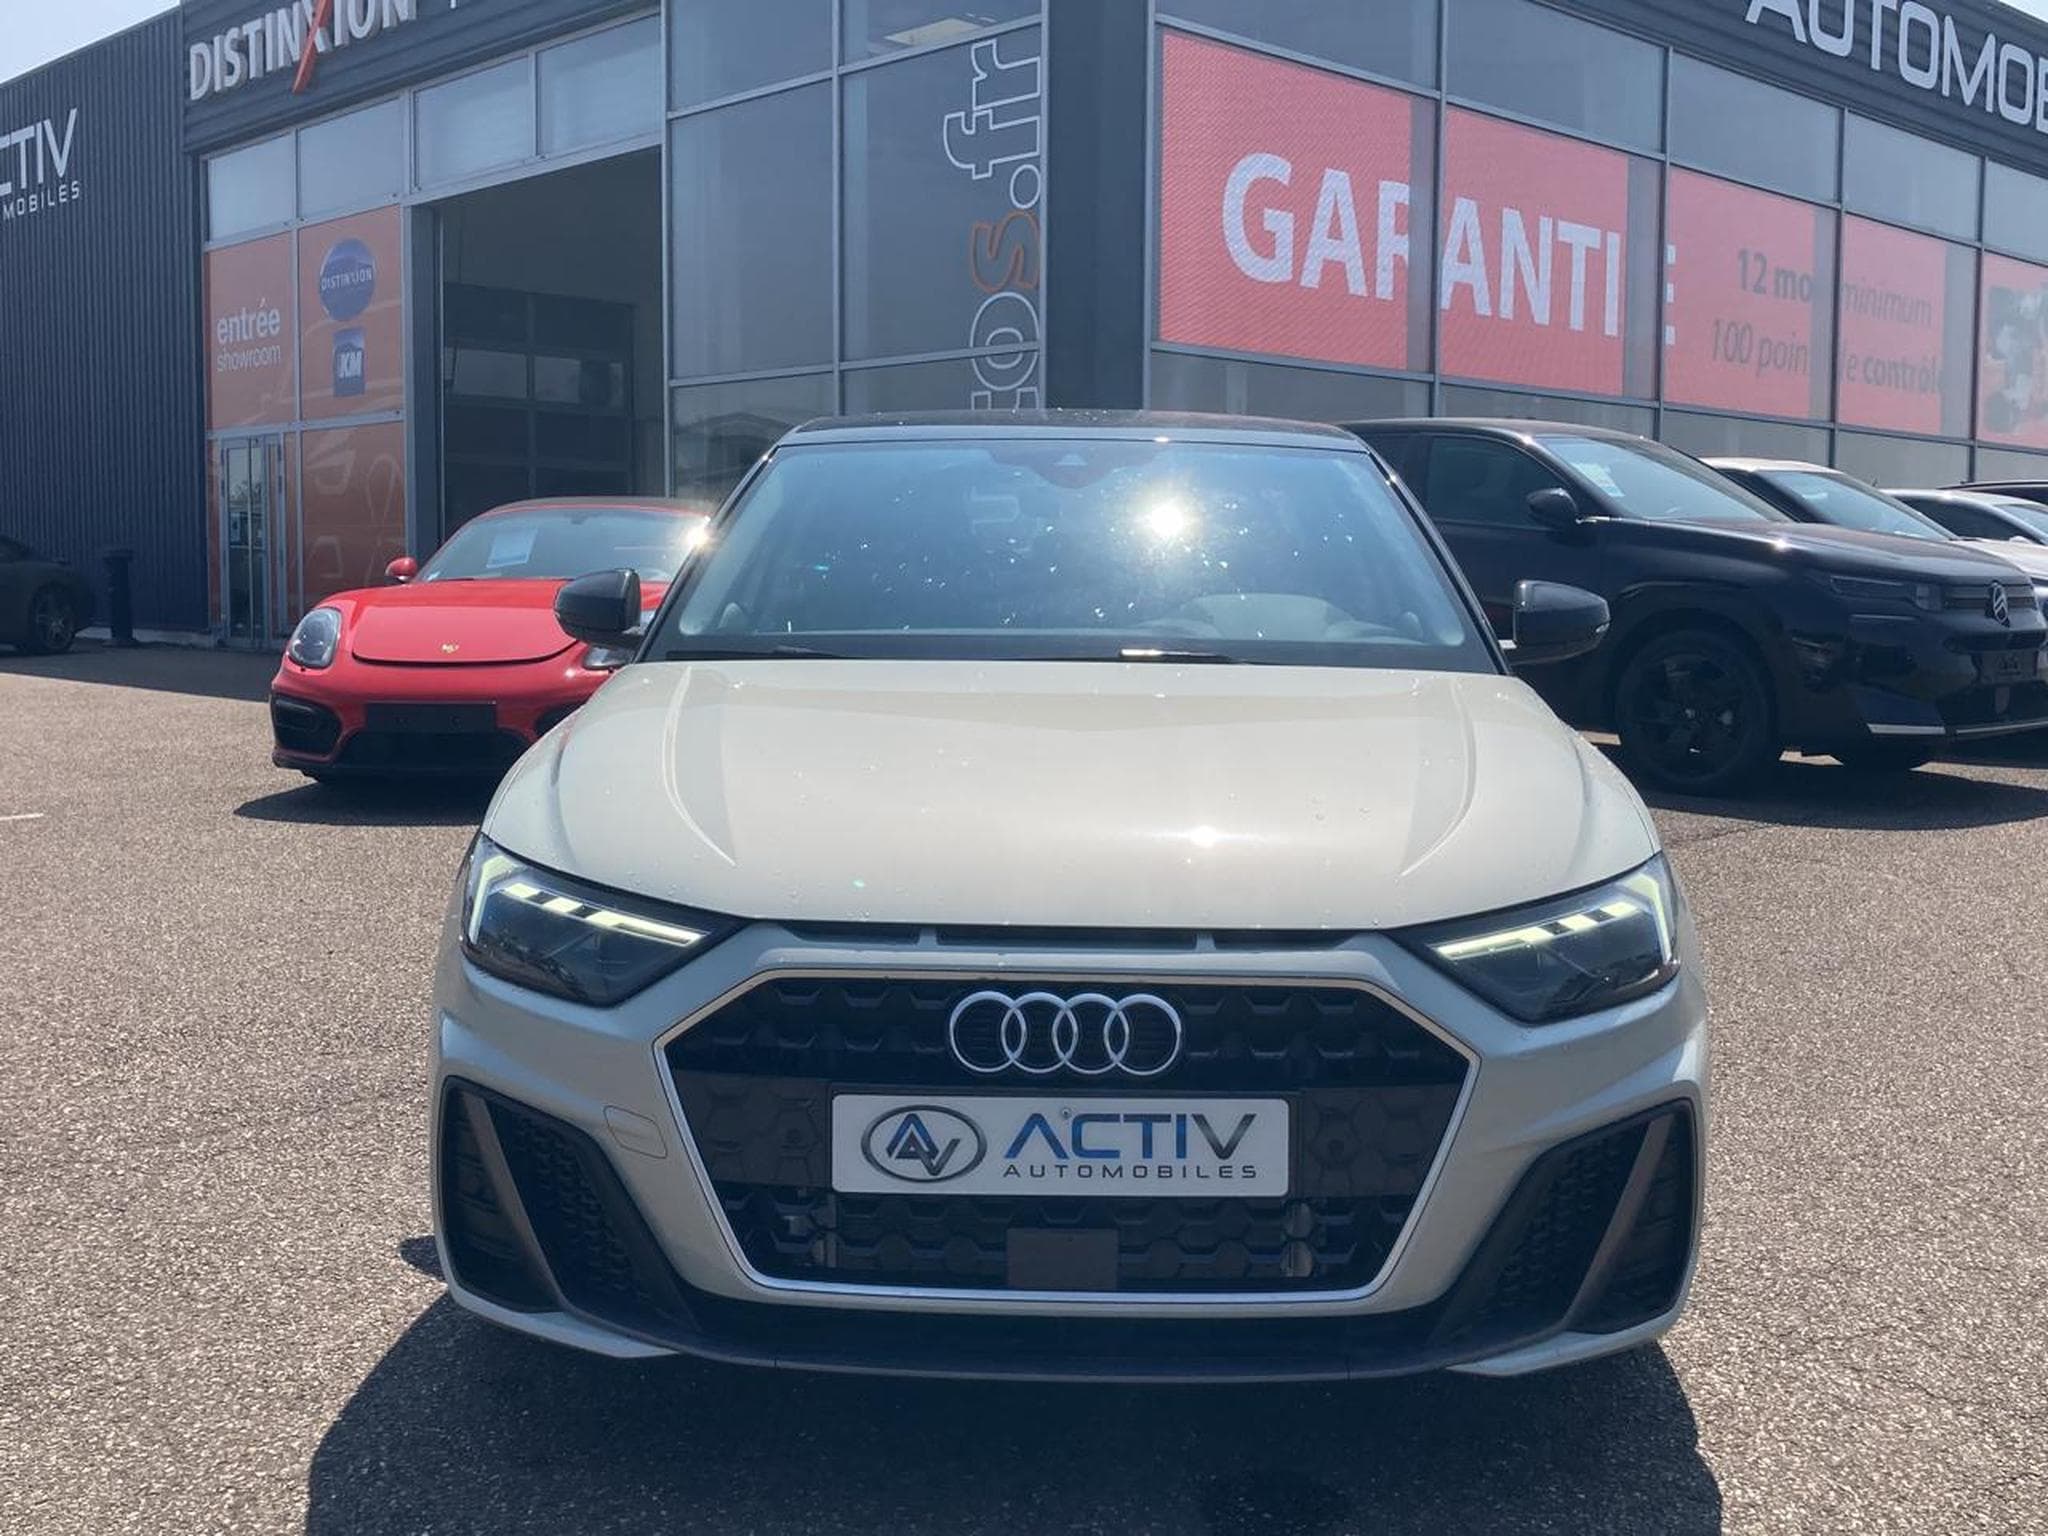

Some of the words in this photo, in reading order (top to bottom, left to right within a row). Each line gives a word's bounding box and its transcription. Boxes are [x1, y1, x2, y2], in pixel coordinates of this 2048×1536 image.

[1222, 151, 1676, 346] GARANTI
[1737, 249, 1769, 296] 12
[216, 297, 281, 345] entrée
[1712, 317, 1754, 365] 100
[216, 344, 281, 373] showroom
[1003, 1112, 1258, 1161] ACTIV
[1002, 1164, 1258, 1180] AUTOMOBILES
